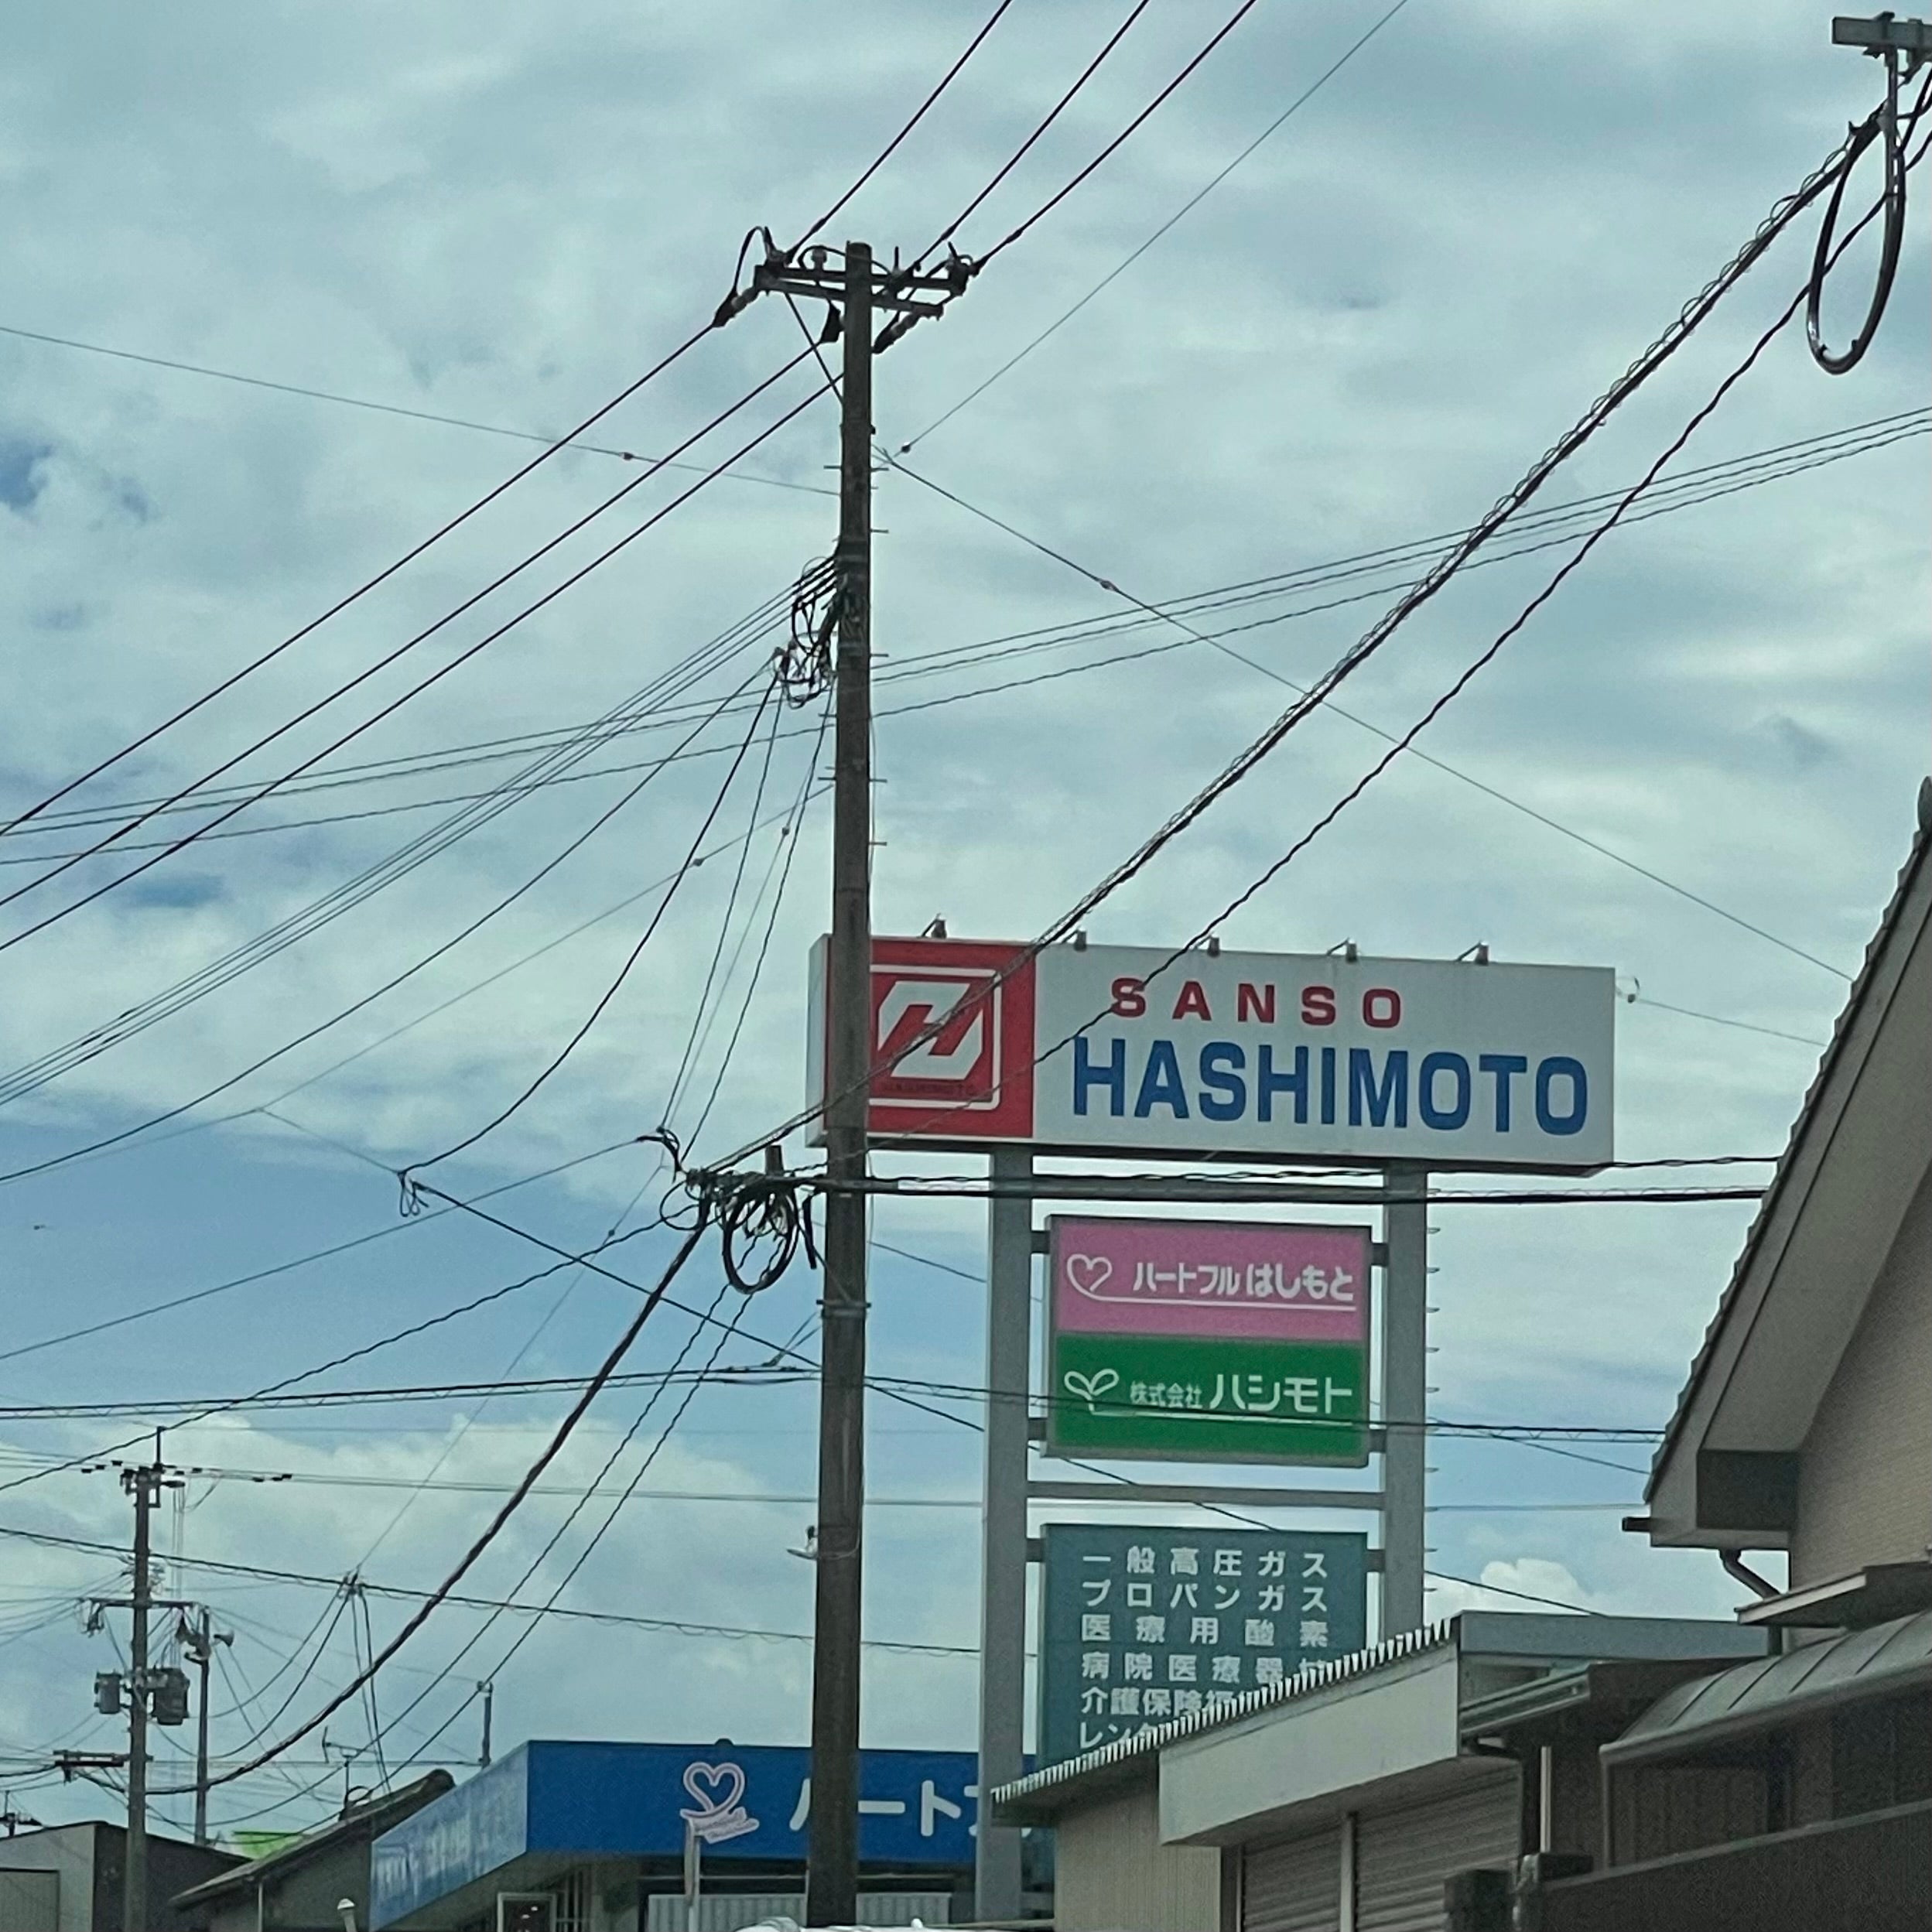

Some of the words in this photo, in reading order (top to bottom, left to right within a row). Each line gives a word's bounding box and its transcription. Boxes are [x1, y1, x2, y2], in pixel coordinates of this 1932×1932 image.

[1111, 976, 1402, 1028] SANSO
[1073, 1036, 1588, 1136] HASHIMOTO
[1082, 1545, 1328, 1579] 一般高圧ガス
[1082, 1579, 1328, 1612] プロパンガス
[1081, 1614, 1328, 1648] 医療用酸素
